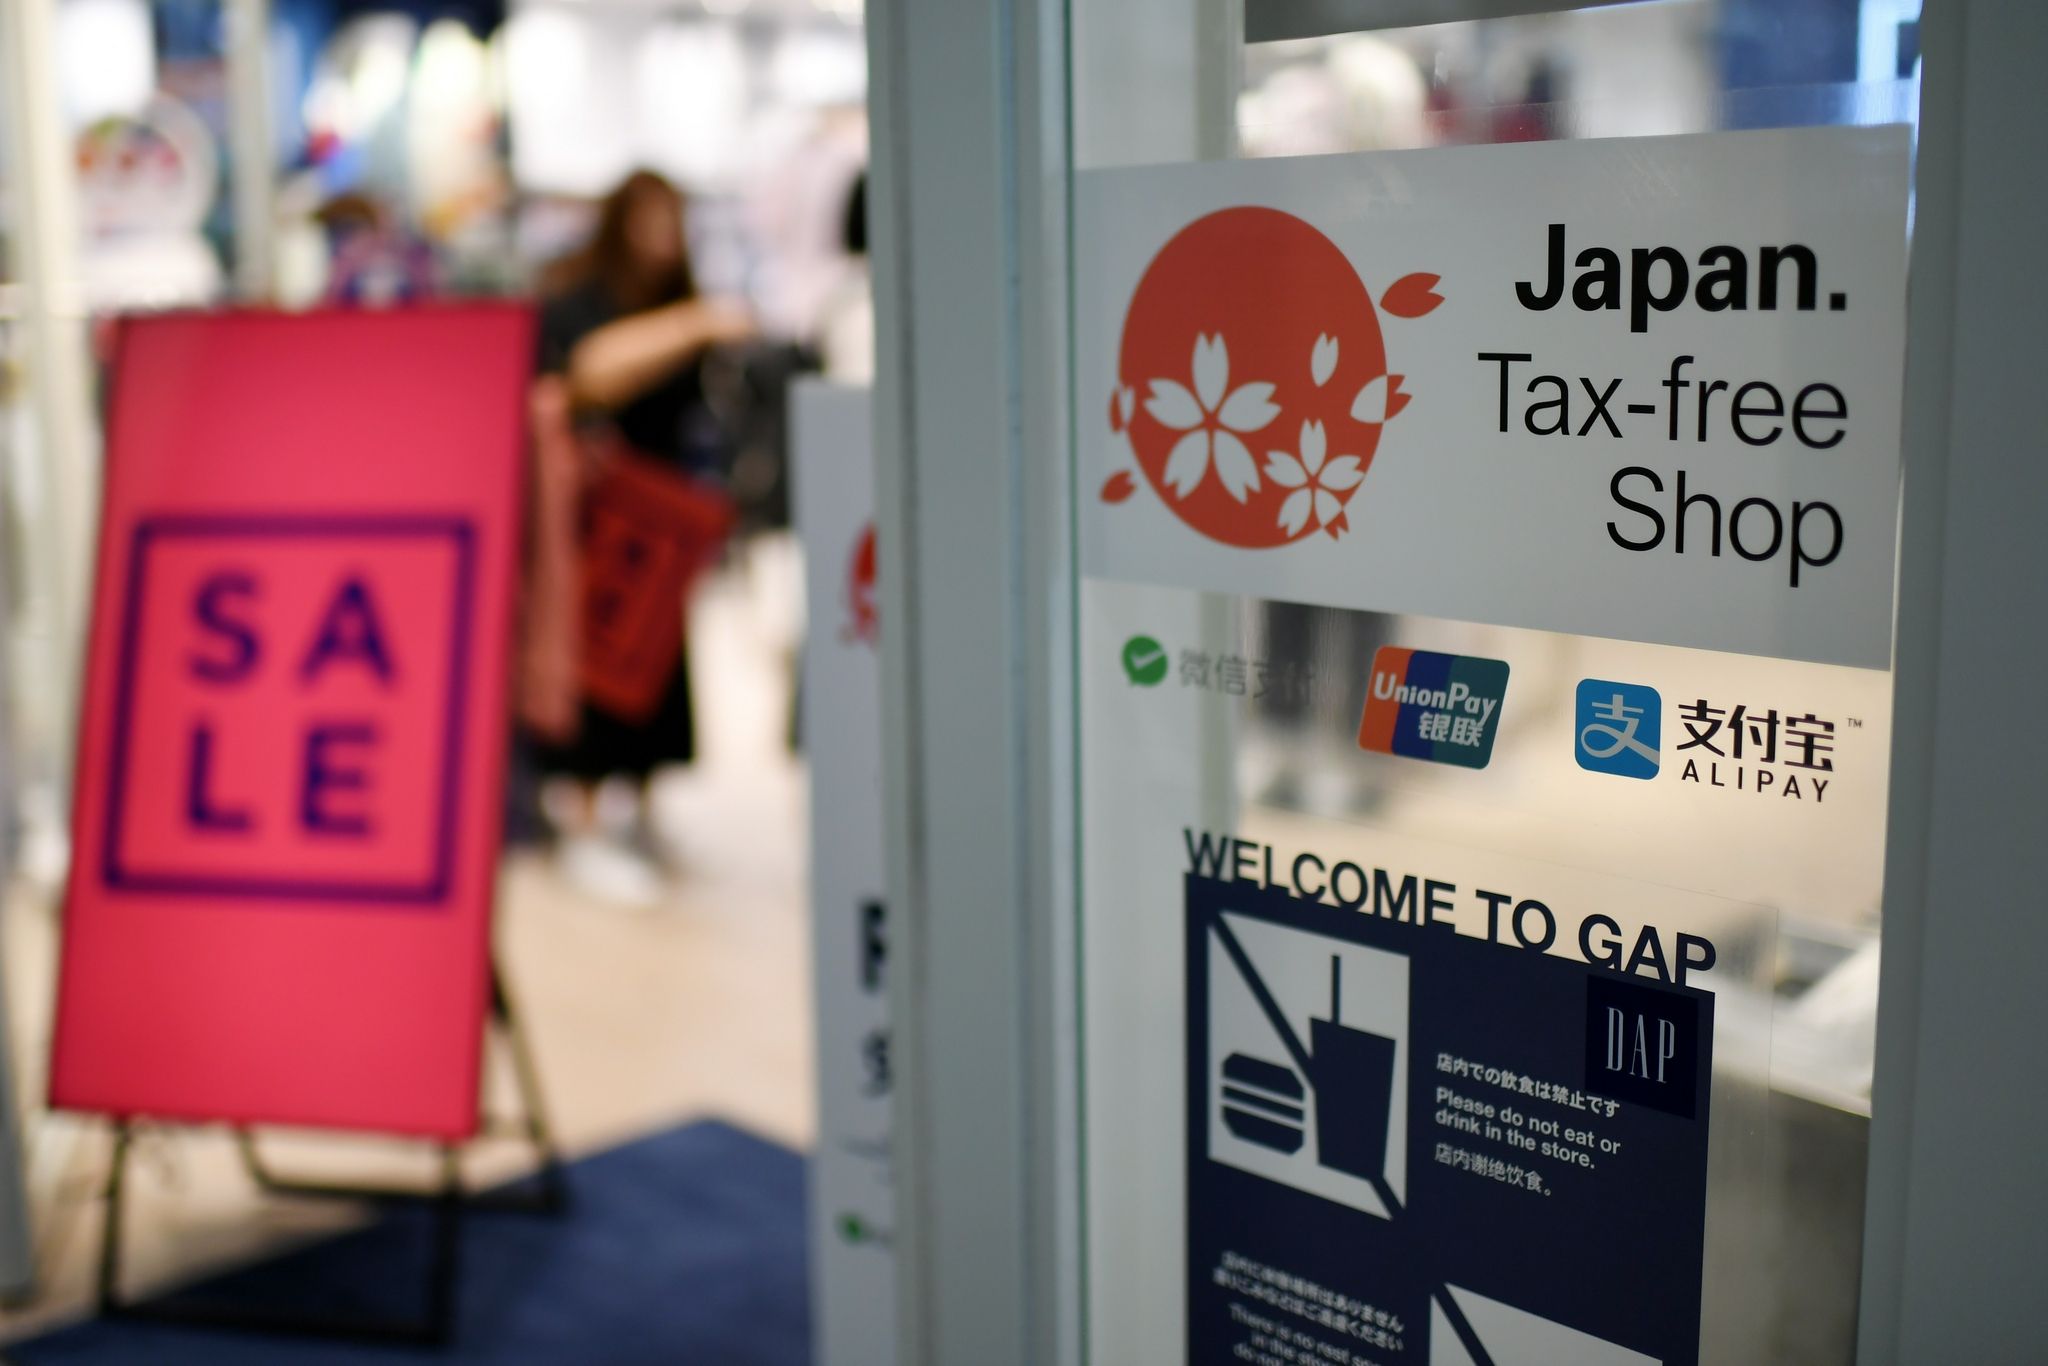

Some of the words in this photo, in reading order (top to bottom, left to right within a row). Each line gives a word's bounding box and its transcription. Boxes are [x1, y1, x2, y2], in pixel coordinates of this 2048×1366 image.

[1514, 224, 1847, 333] Japan.
[1477, 352, 1848, 449] Tax-free
[1606, 466, 1843, 588] Shop
[1373, 671, 1498, 726] UnionPay
[1418, 711, 1484, 748] 银联
[1676, 699, 1835, 772] 支付宝
[1681, 758, 1830, 803] ALIPAY
[1184, 827, 1456, 933] WELCOME
[1475, 888, 1557, 953] TO
[1577, 913, 1717, 987] GAP
[1605, 1006, 1676, 1084] DAP
[1436, 1052, 1620, 1118] 店内での飲食は禁止です
[1435, 1108, 1481, 1136] drink
[1485, 1121, 1501, 1141] in
[1506, 1128, 1537, 1151] the
[1541, 1140, 1596, 1170] store.
[1436, 1086, 1495, 1119] Please
[1500, 1107, 1524, 1126] do
[1528, 1116, 1560, 1138] not
[1564, 1127, 1595, 1149] eat
[1600, 1139, 1621, 1155] or
[1434, 1142, 1551, 1197] 店内谢绝饮食。
